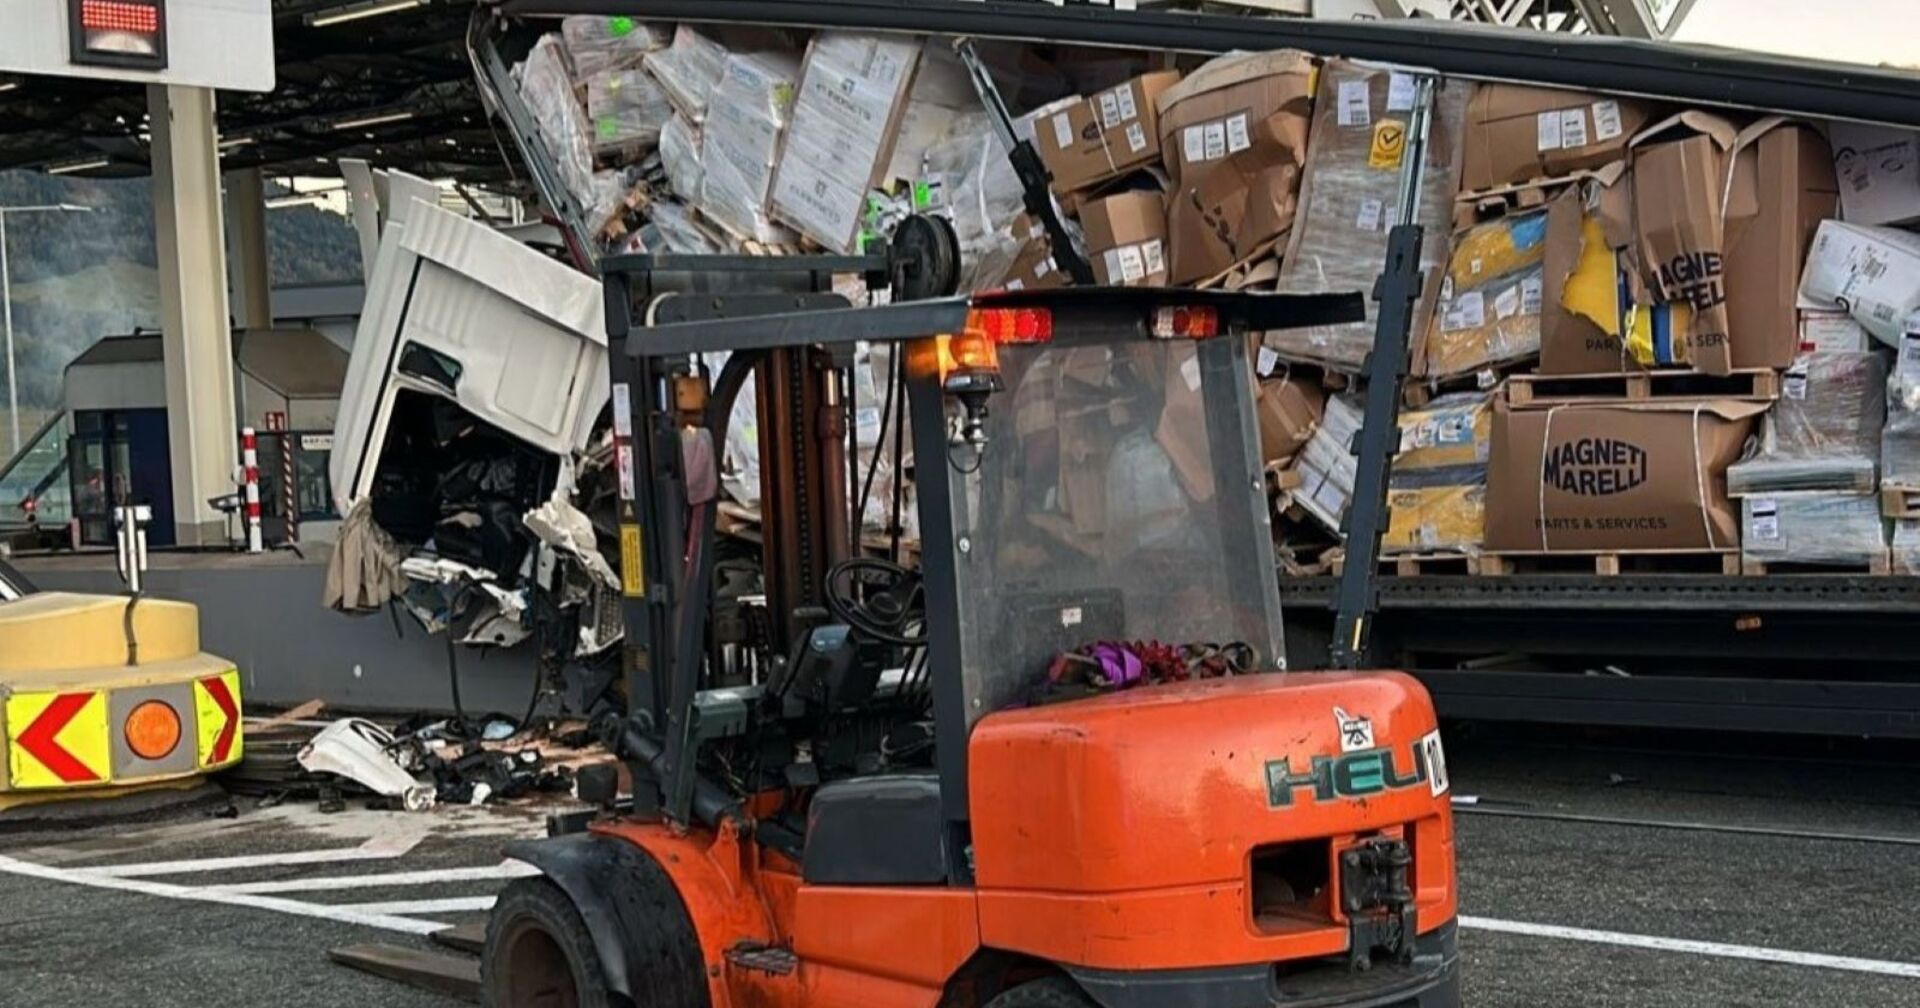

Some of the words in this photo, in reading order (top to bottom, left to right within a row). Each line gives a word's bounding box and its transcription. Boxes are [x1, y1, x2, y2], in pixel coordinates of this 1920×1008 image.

[1651, 251, 1724, 294] AGNE
[1543, 437, 1648, 474] MAGNETI
[1543, 461, 1648, 497] MARELLI
[1535, 517, 1581, 530] PARTS
[1583, 517, 1594, 530] &
[1595, 517, 1668, 530] SERVICES
[1265, 740, 1430, 808] HELI
